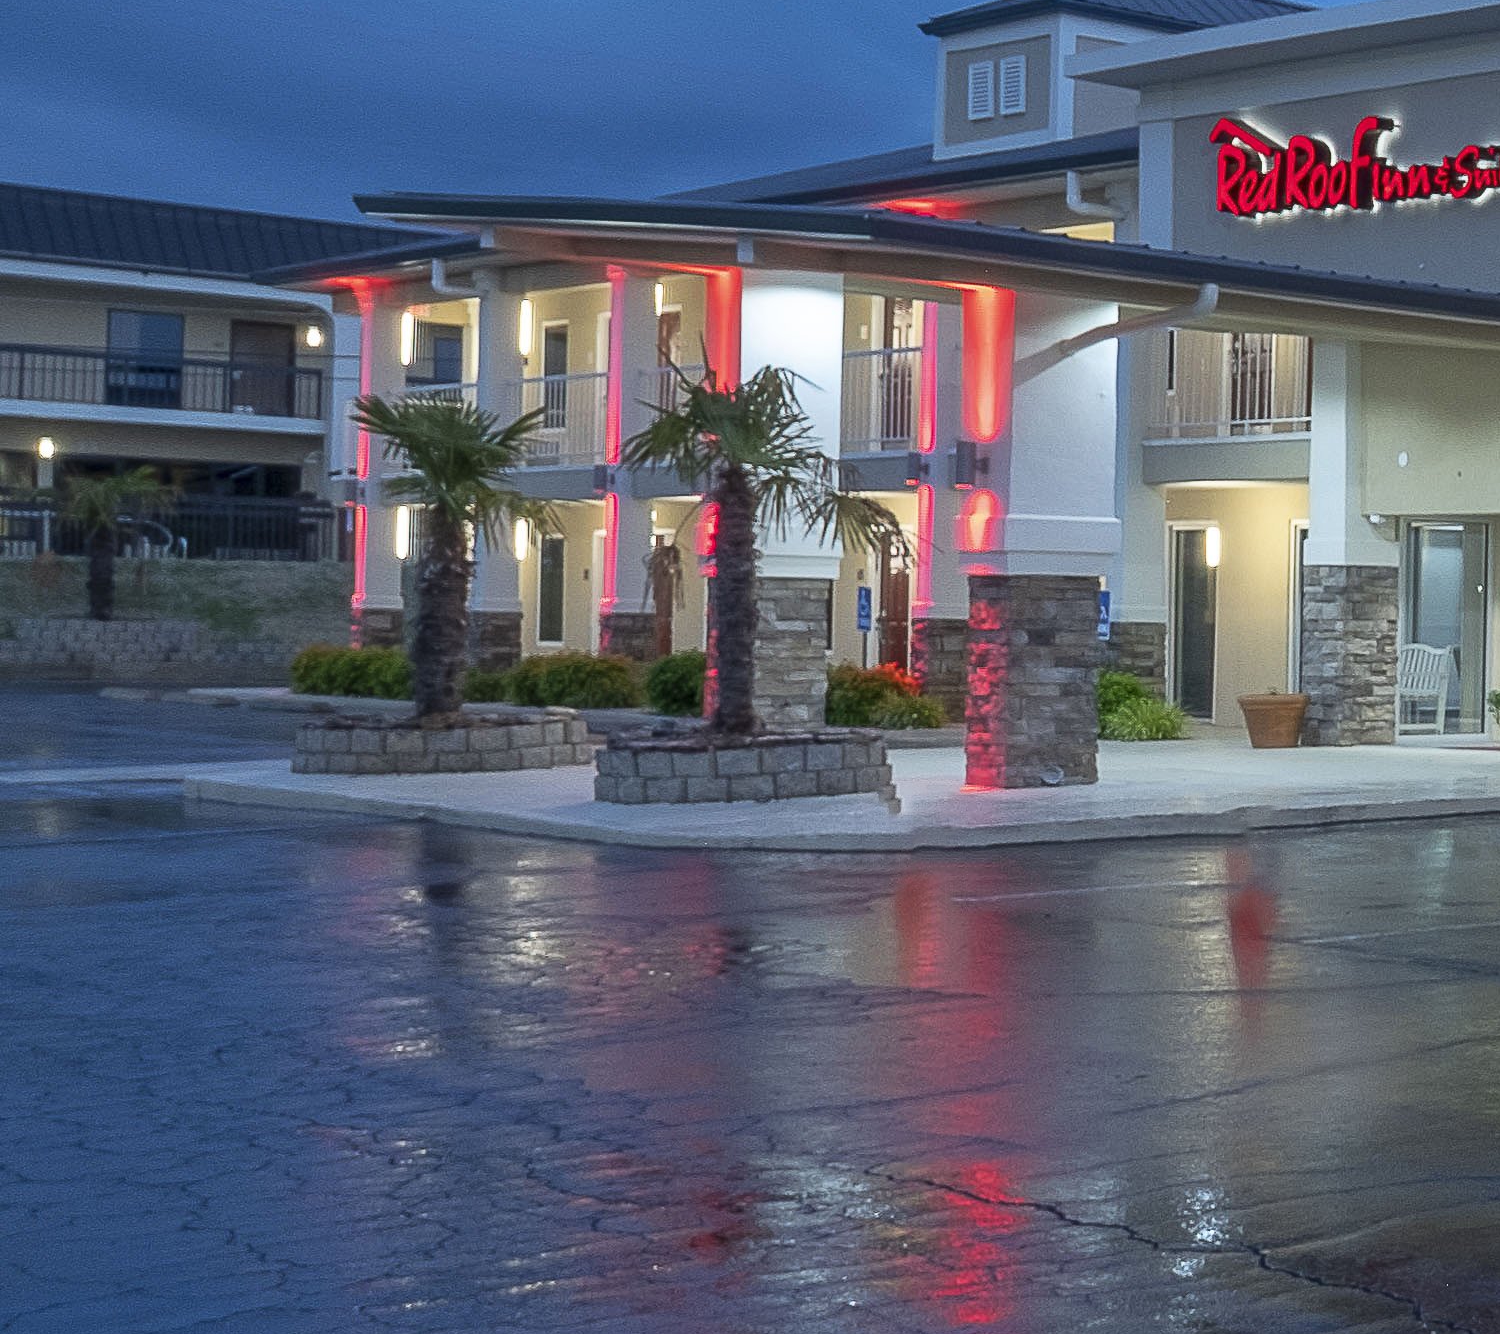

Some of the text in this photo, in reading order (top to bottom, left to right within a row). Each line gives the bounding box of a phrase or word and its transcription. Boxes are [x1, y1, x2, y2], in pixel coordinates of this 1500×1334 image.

[1216, 143, 1281, 216] Red
[1286, 115, 1379, 209] Roof
[1372, 162, 1431, 201] Inn
[1433, 157, 1451, 193] &
